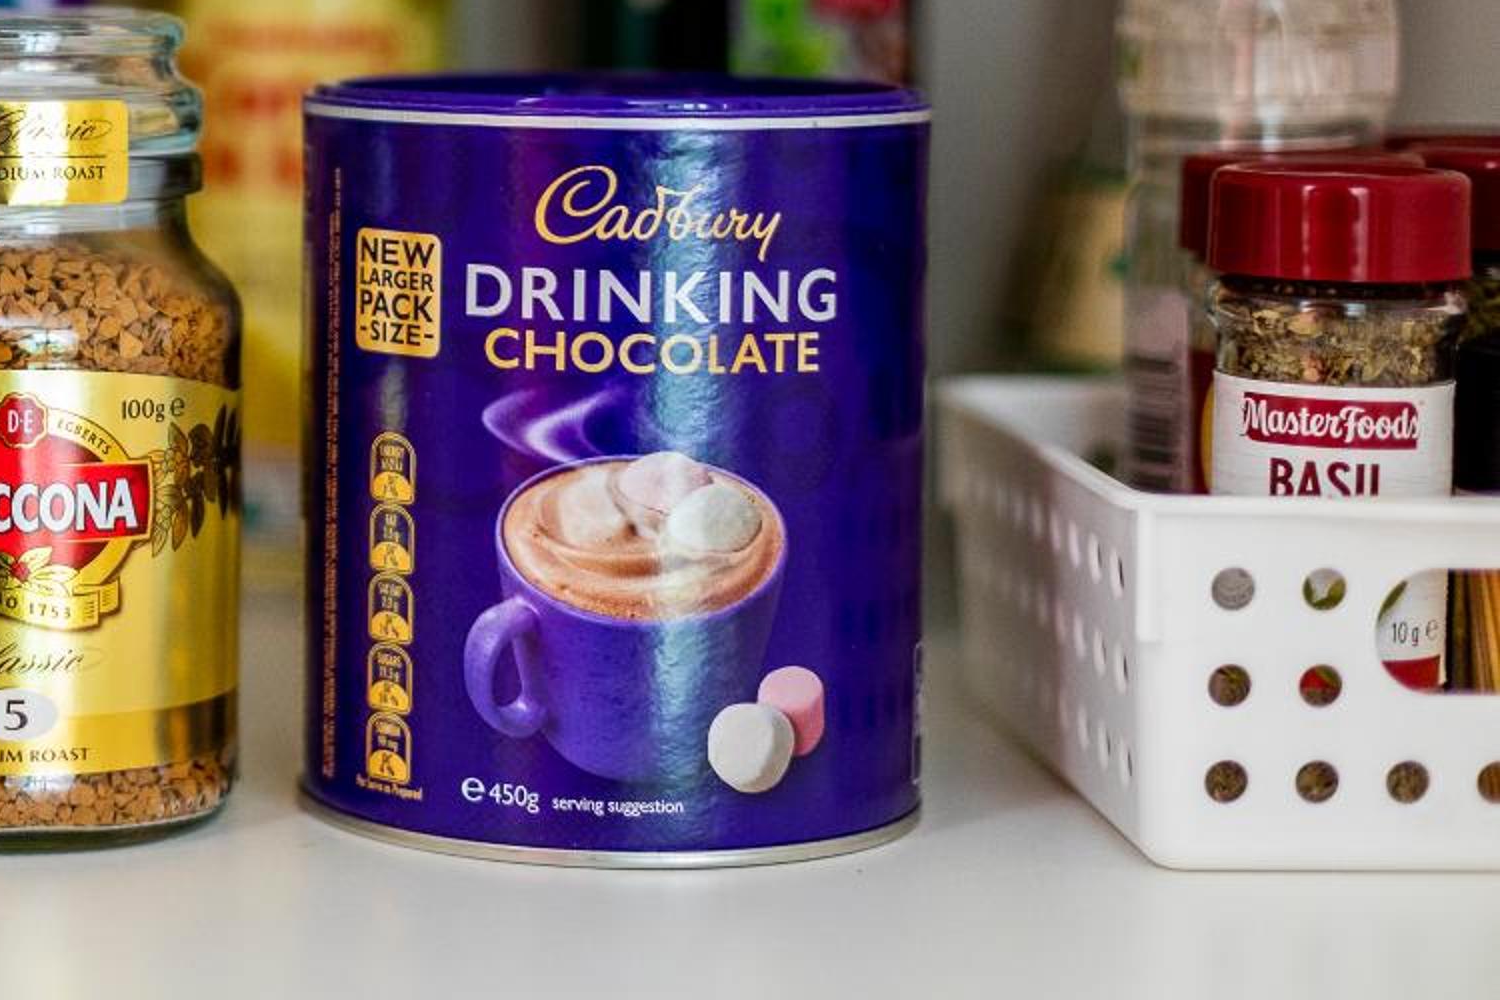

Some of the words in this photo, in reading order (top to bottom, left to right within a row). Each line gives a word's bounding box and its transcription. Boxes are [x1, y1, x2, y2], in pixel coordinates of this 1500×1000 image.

[53, 164, 106, 180] ROAST
[534, 165, 781, 262] Cadbury
[360, 236, 435, 268] NEW
[360, 267, 434, 292] LARGER
[465, 264, 837, 324] DRINKING
[360, 289, 433, 322] PACK
[484, 328, 819, 375] CHOCOLATE
[122, 400, 164, 422] 100g
[1241, 398, 1421, 443] MasterFoods
[57, 419, 111, 455] EGBERTS
[1393, 622, 1407, 644] 10
[4, 700, 28, 731] 5
[29, 747, 89, 762] ROAST
[489, 784, 540, 814] 450g
[552, 798, 604, 816] serving
[607, 800, 684, 817] suggestion
